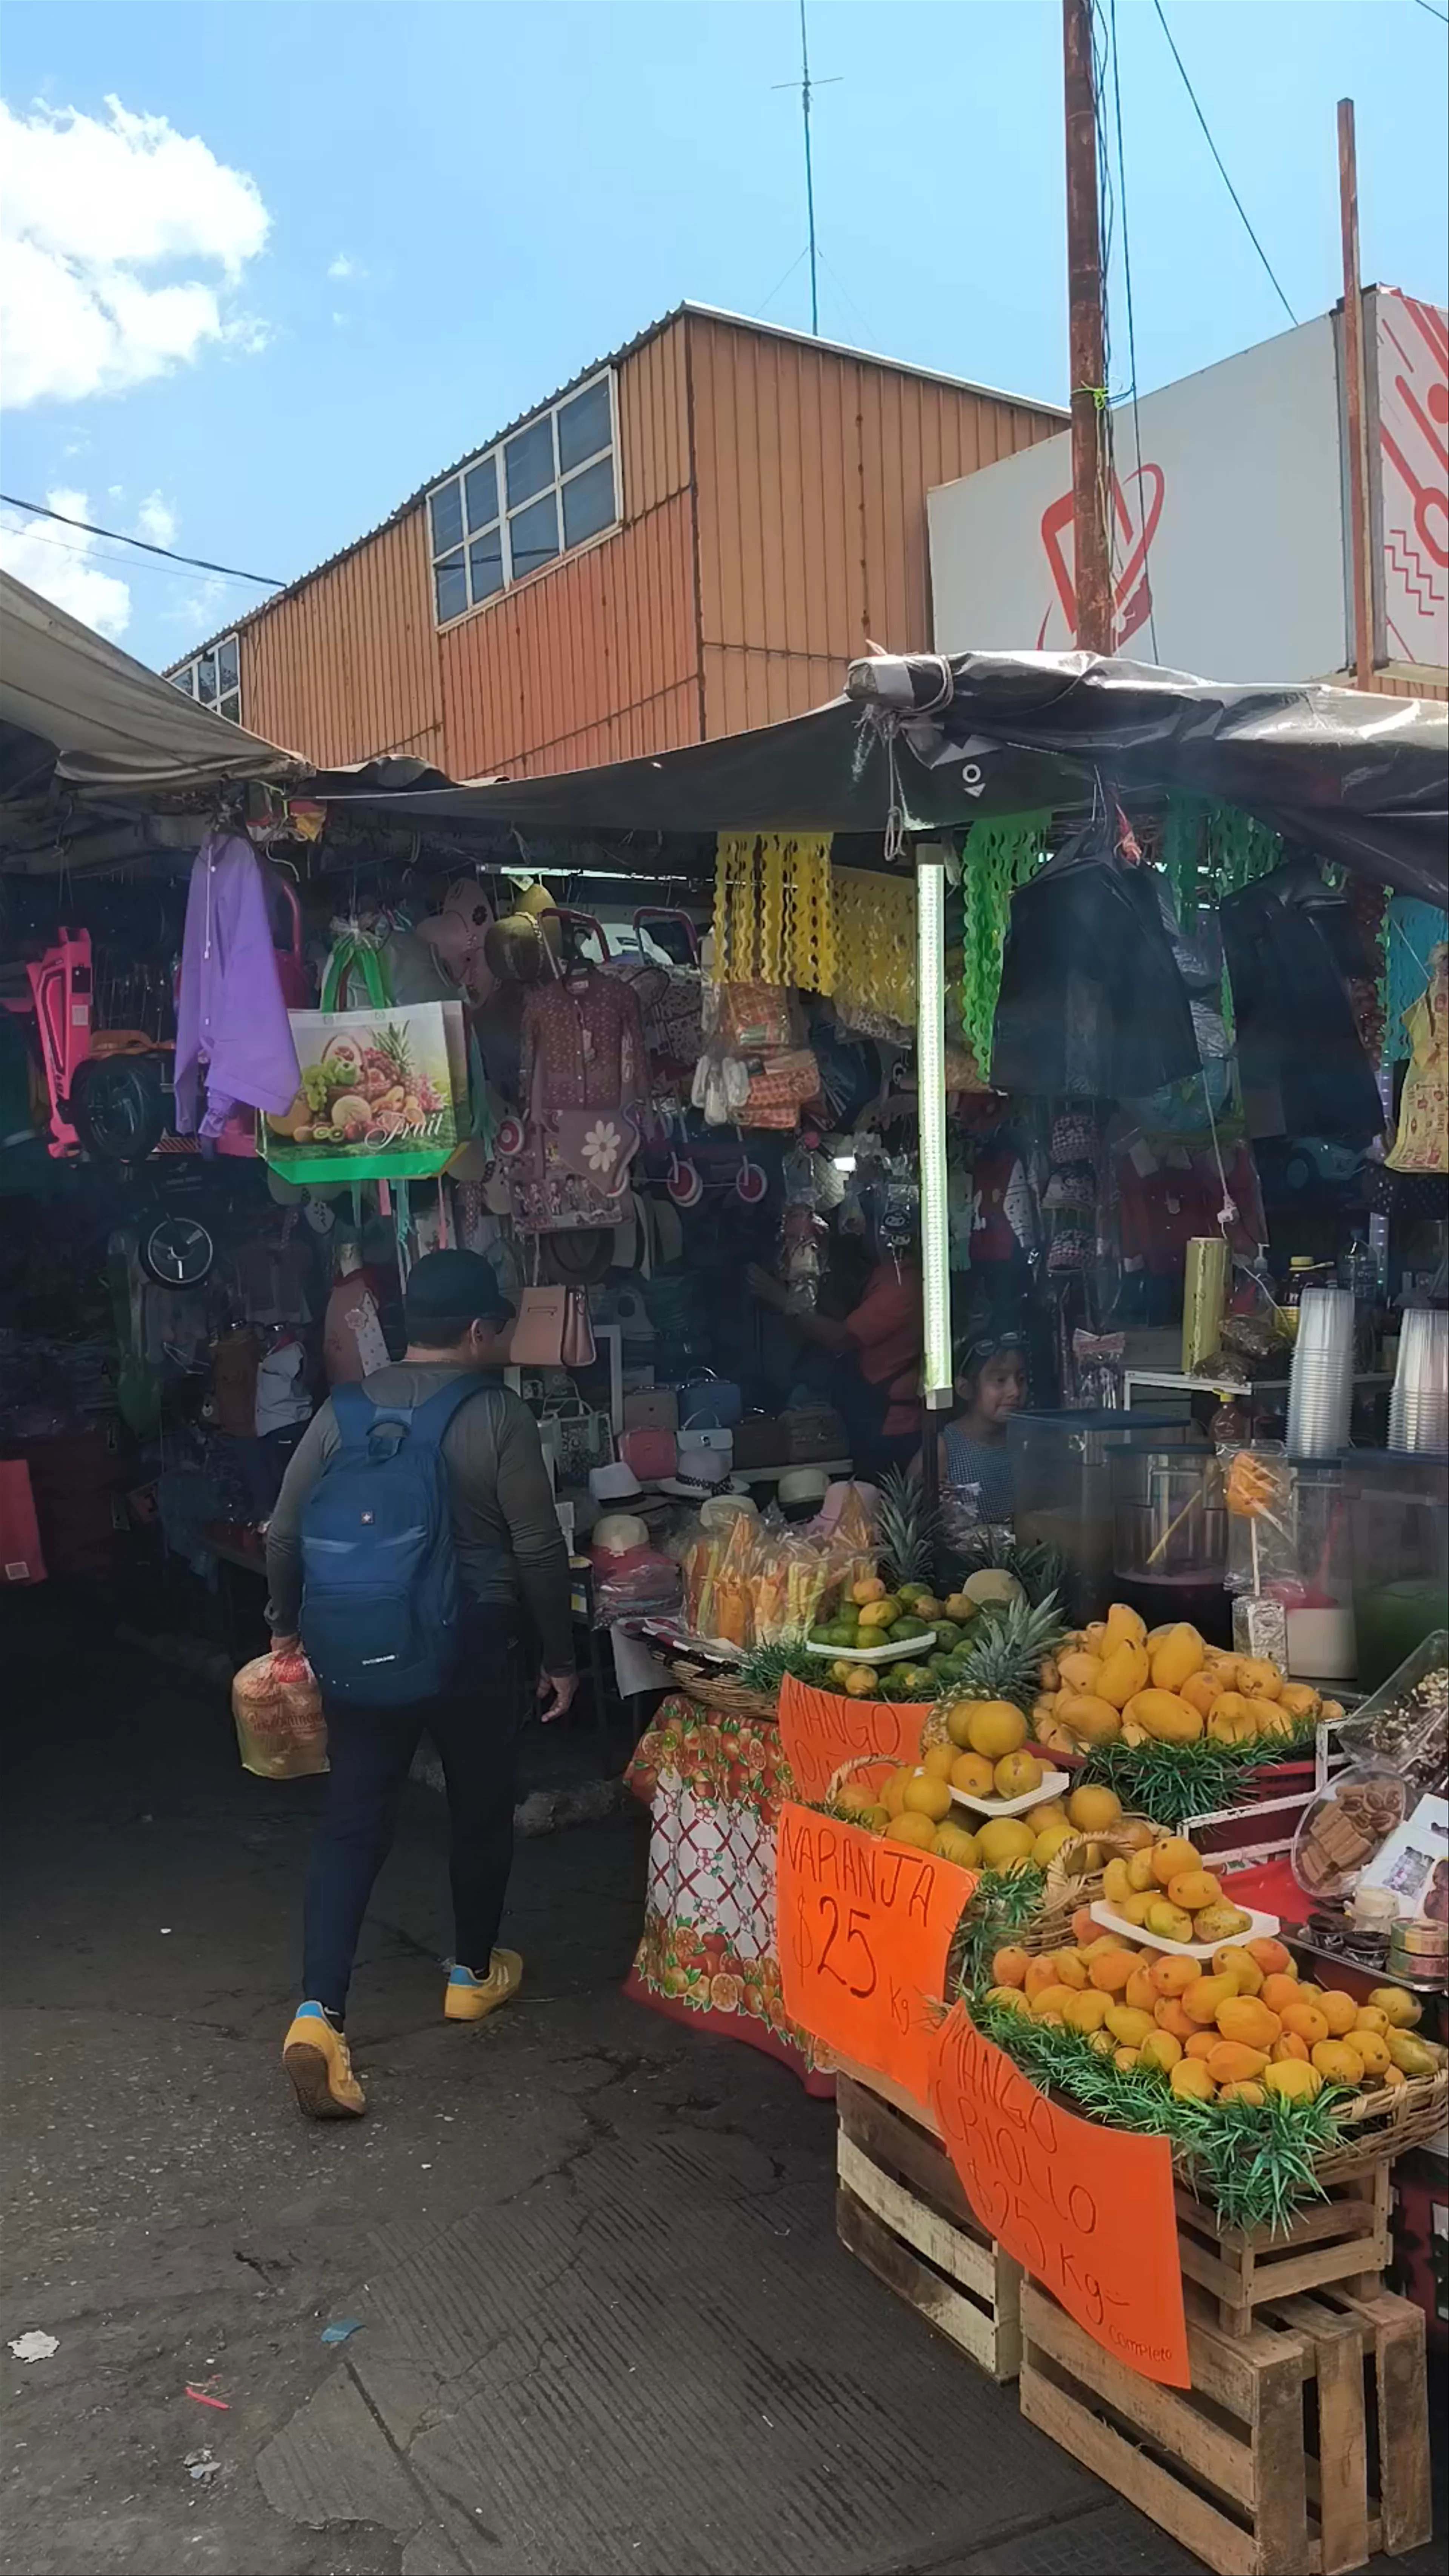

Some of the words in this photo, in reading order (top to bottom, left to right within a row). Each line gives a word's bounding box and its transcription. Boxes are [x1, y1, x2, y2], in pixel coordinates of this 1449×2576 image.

[788, 1675, 900, 1755] MANGO
[782, 1817, 935, 1927] NARANJA
[939, 2010, 1057, 2154] MANGO
[936, 2078, 1097, 2234] CRIOLLO
